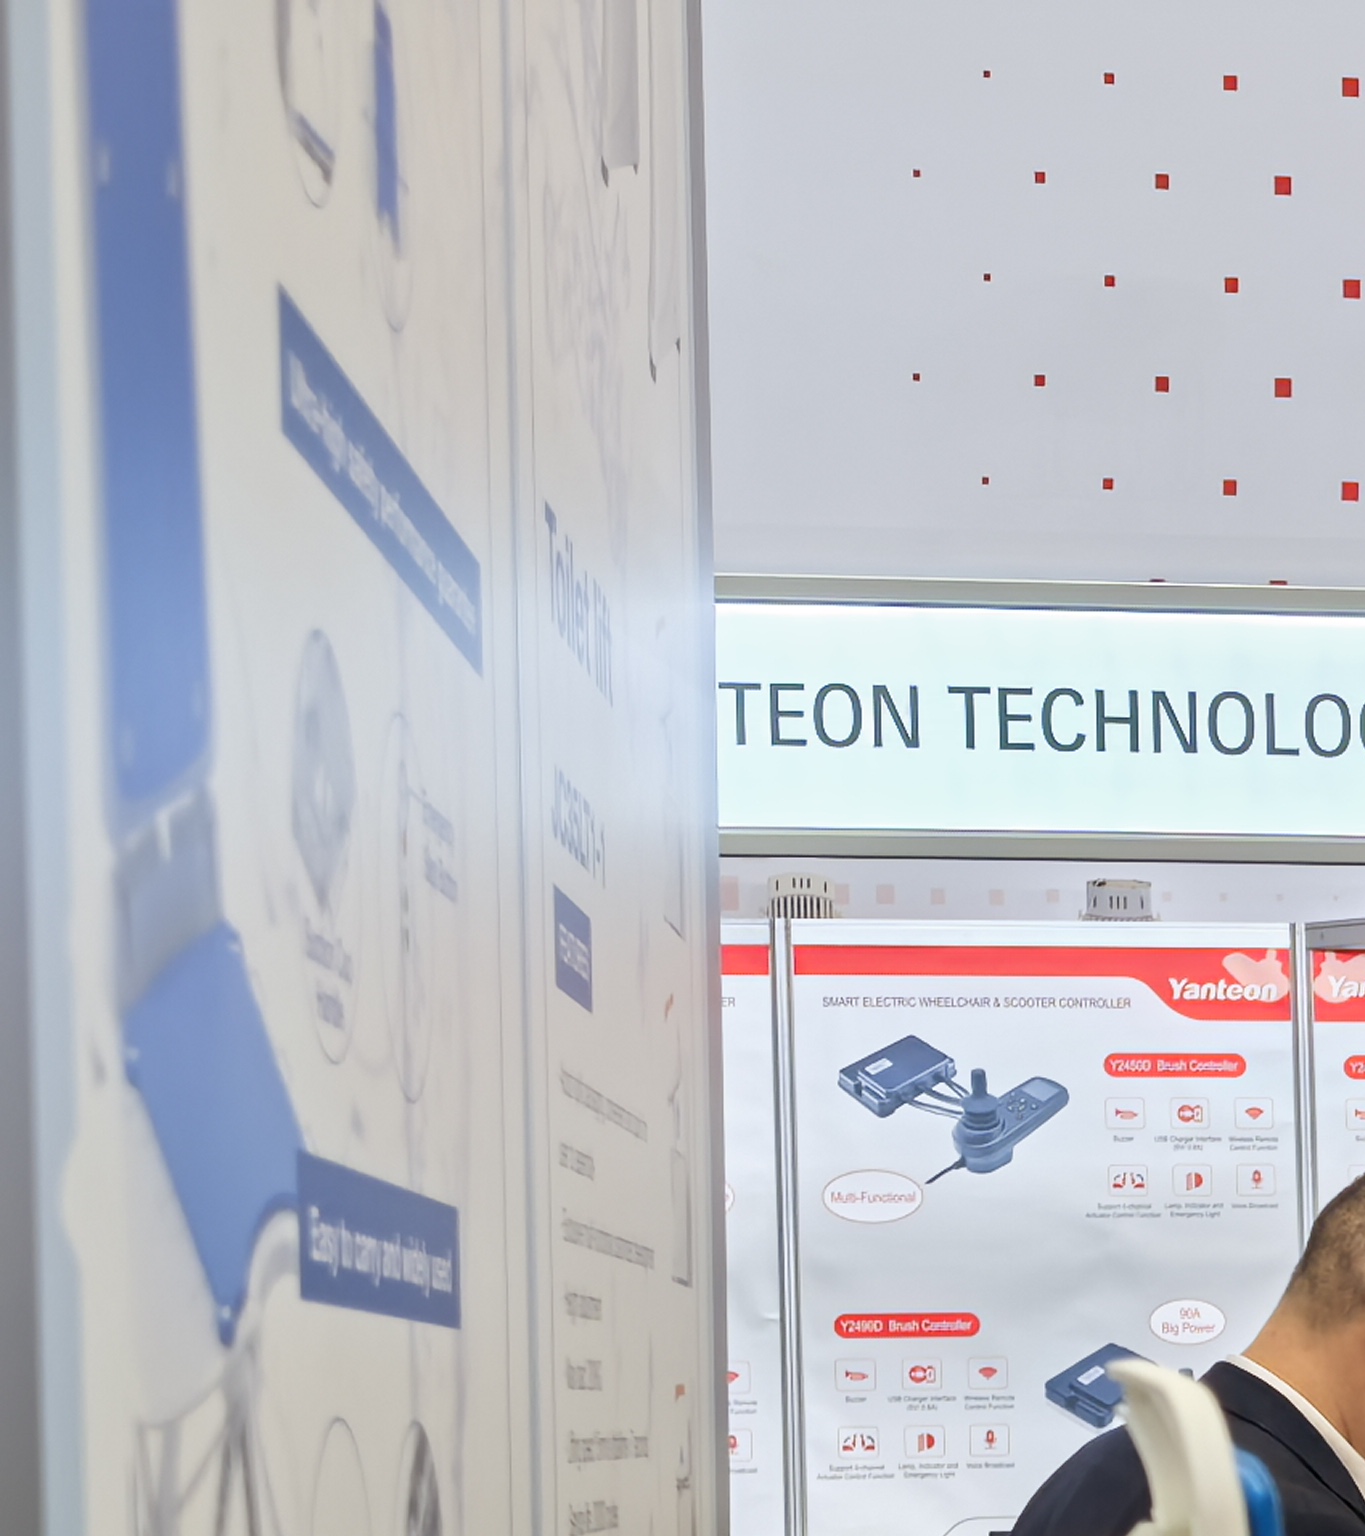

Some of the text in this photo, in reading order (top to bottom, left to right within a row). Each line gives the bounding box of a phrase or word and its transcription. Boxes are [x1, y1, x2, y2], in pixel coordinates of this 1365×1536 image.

[545, 501, 614, 708] Toilet lift
[718, 682, 921, 750] TEON
[822, 996, 859, 1008] SMART
[863, 996, 916, 1008] ELECTRIC
[919, 997, 990, 1008] WHEELCHAIR
[1003, 997, 1056, 1009] SCOOTER
[1058, 997, 1131, 1009] CONTROLLER
[1168, 976, 1279, 1003] Yanteon
[308, 1204, 340, 1278] Easy
[340, 1218, 353, 1269] to
[382, 1232, 402, 1280] and
[889, 1319, 919, 1333] Brush
[921, 1318, 973, 1332] Controller
